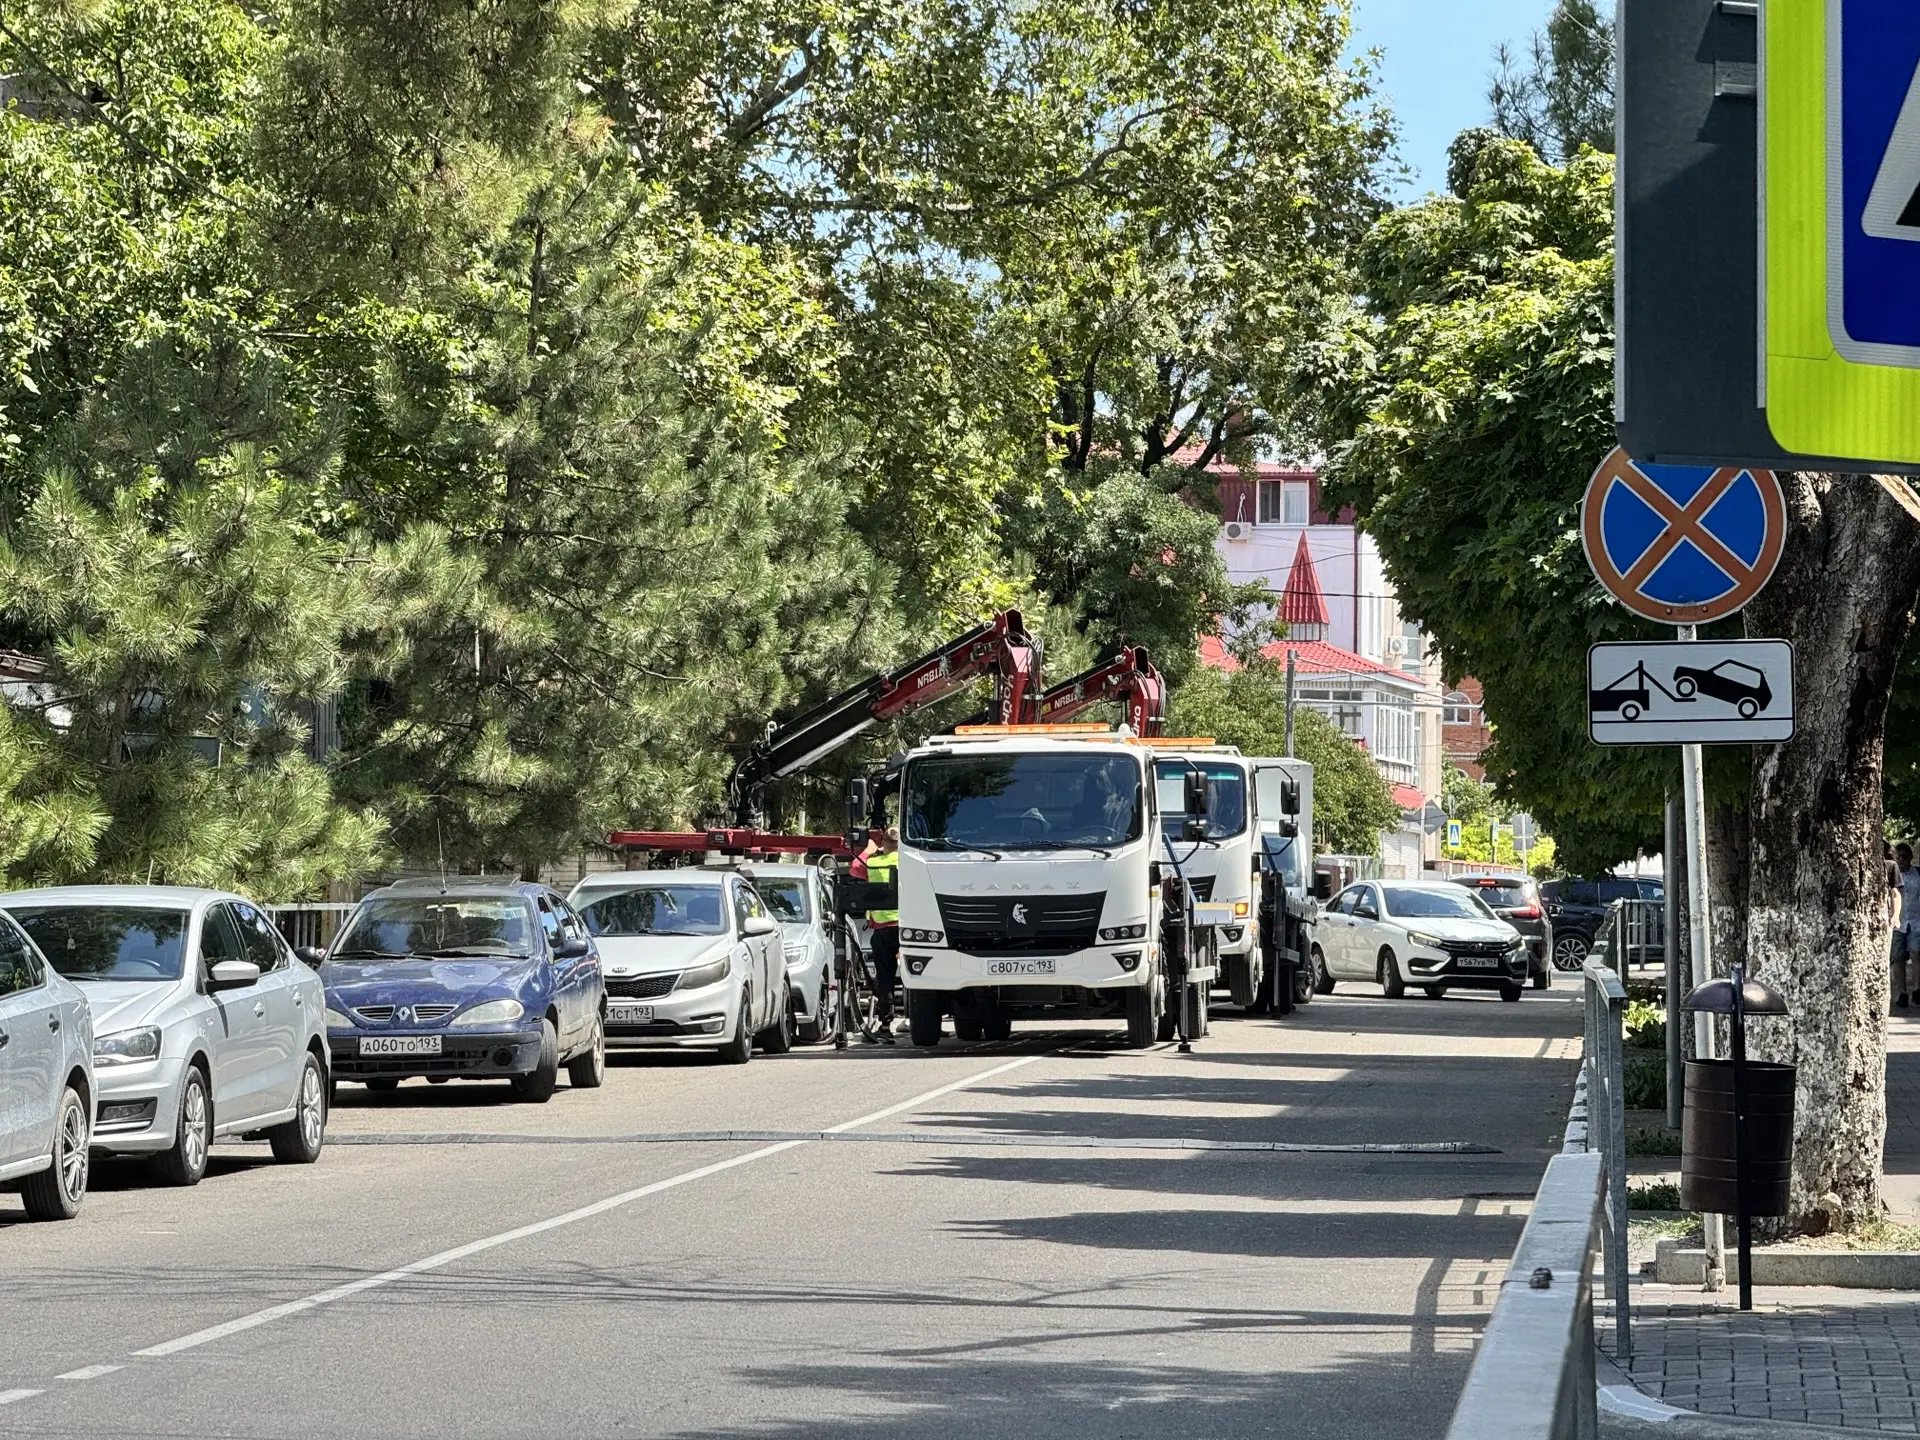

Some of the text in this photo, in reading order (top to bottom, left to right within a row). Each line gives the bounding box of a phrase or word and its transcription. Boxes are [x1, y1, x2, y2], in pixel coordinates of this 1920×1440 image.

[1036, 960, 1053, 970] 193
[633, 1007, 650, 1016] 193
[418, 1037, 438, 1048] 193
